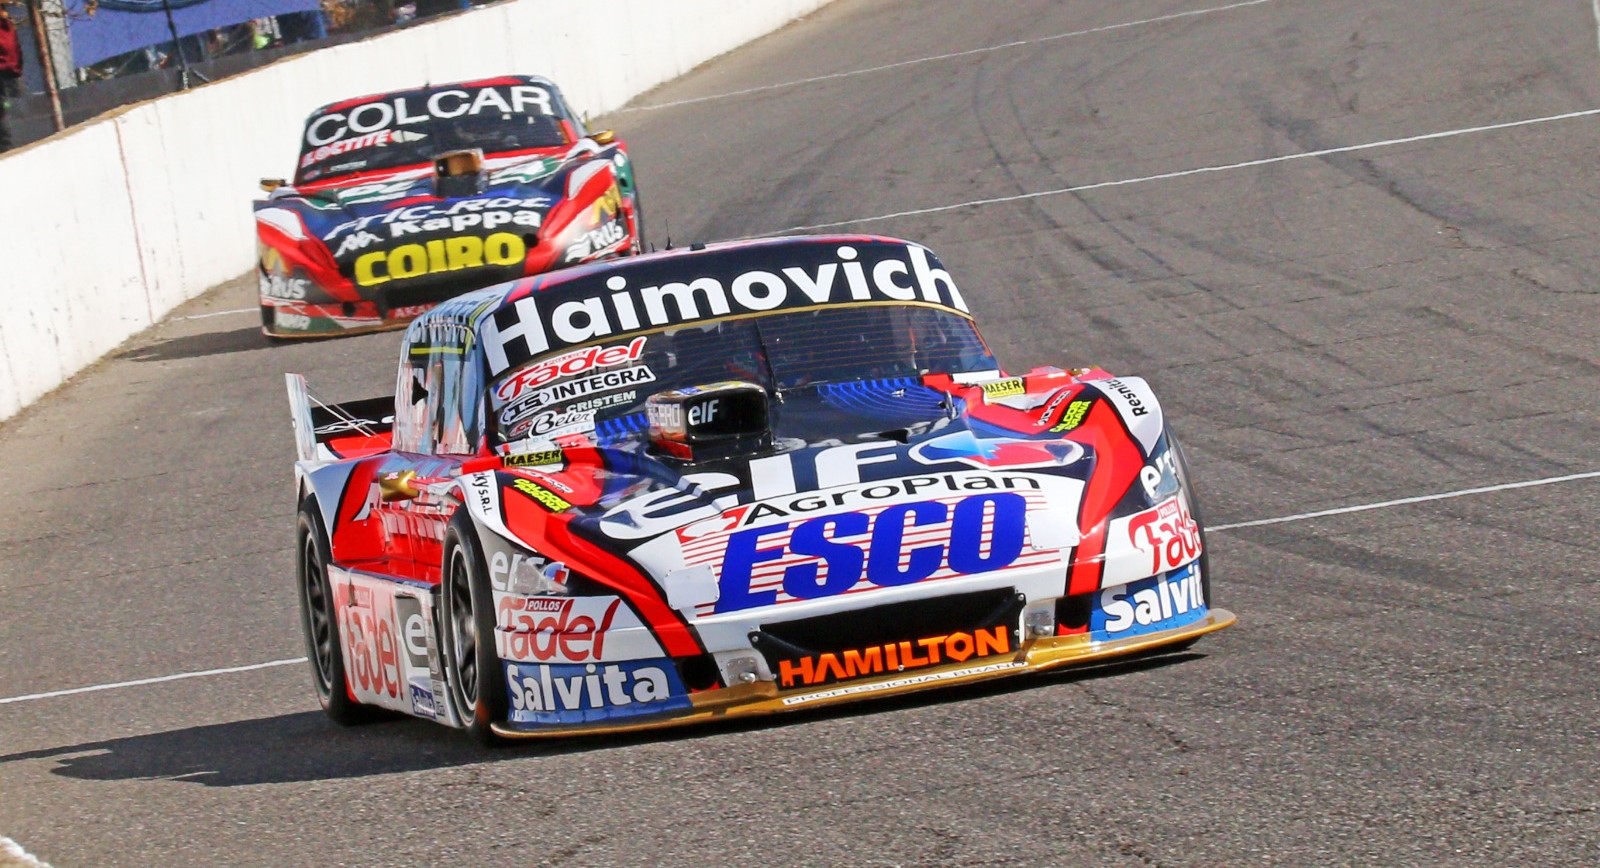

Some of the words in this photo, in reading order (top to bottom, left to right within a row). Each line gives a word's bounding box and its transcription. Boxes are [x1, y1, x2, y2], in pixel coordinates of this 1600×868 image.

[306, 85, 553, 147] COLCAR
[301, 129, 391, 168] LOCTITE
[390, 209, 541, 238] Kappa
[354, 232, 525, 287] COIRO
[480, 244, 970, 377] Haimovich
[498, 338, 644, 399] Fadel
[553, 368, 651, 400] INTEGRA
[984, 379, 1021, 393] KAESER
[566, 391, 636, 414] CRISTEM
[688, 400, 719, 426] elf
[505, 450, 560, 466] KAESER
[599, 440, 897, 540] elf
[713, 491, 1027, 614] ESCO
[498, 596, 622, 662] Fadel
[528, 600, 561, 612] POLLOS
[778, 625, 1009, 688] HAMILTON
[506, 662, 672, 712] Salvita
[787, 675, 943, 705] PROFESSIONAL
[951, 660, 1026, 677] BRAND
